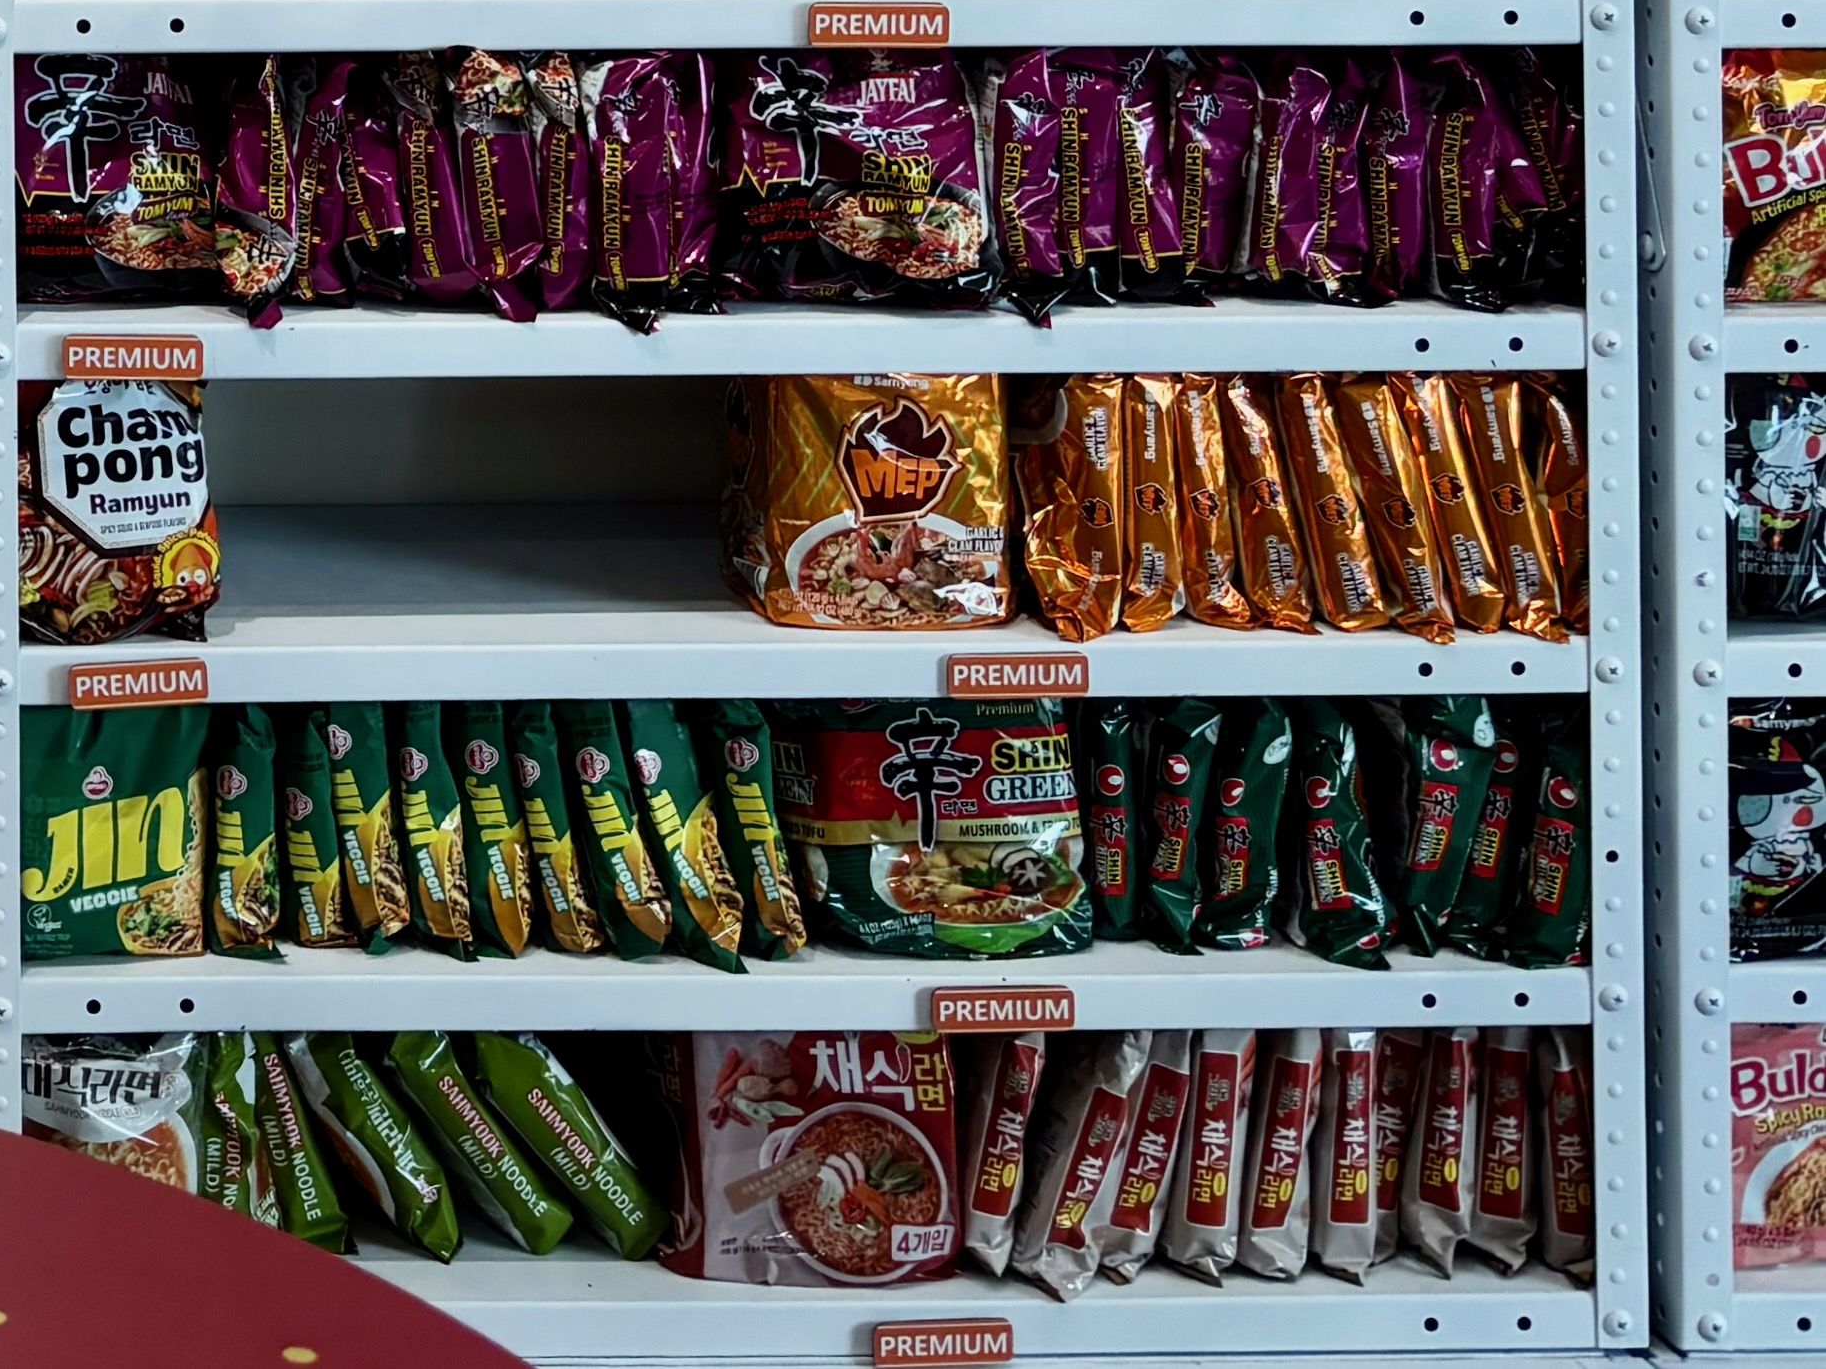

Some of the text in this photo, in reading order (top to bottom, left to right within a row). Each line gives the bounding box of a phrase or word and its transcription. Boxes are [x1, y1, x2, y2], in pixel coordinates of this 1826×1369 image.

[814, 12, 945, 38] PREMIUM
[67, 344, 198, 372] PREMIUM
[62, 438, 206, 500] pong
[88, 487, 191, 517] Ramyun
[74, 669, 204, 698] PREMIUM
[953, 661, 1083, 688] PREMIUM
[990, 738, 1071, 771] SHIN
[984, 773, 1078, 804] GREEN
[68, 884, 140, 914] VEGGIE
[938, 996, 1071, 1023] PREMIUM
[436, 1074, 550, 1218] SAHMYOOK NOODLE
[457, 1131, 498, 1179] (MILD)
[894, 1229, 948, 1257] 4개입
[879, 1331, 1009, 1359] PREMIUM
